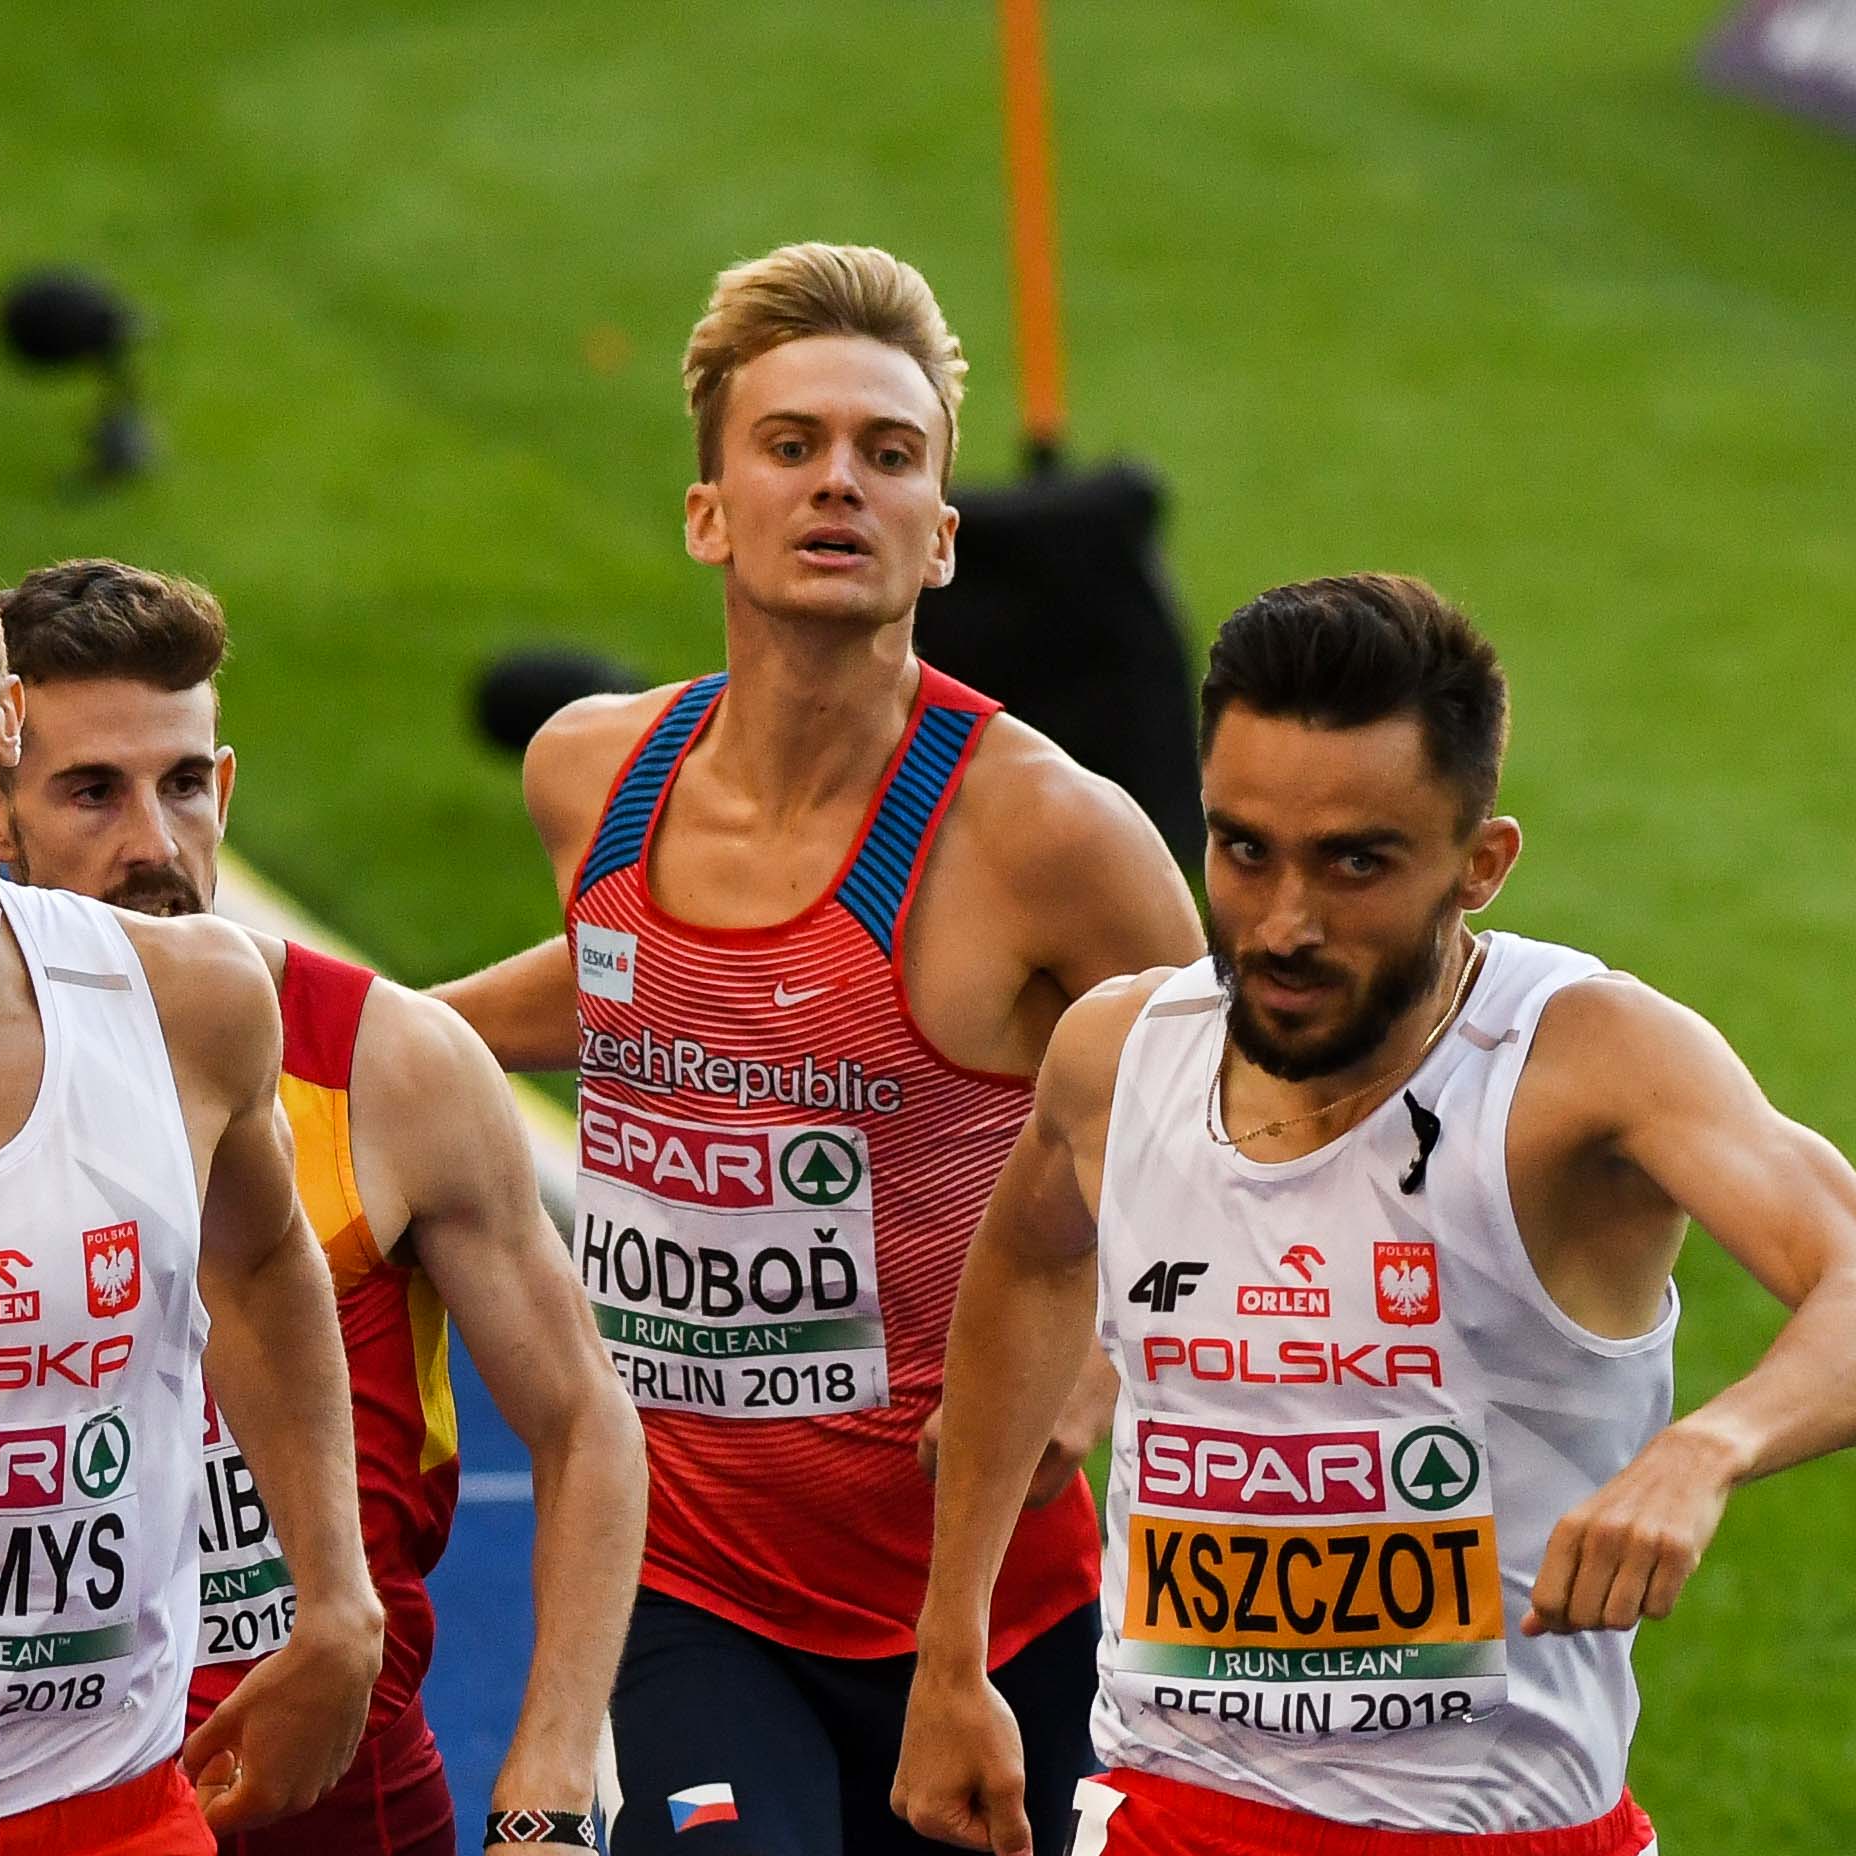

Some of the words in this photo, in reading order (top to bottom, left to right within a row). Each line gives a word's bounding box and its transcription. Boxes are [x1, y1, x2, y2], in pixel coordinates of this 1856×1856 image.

[577, 1014, 902, 1113] zechRepublic
[583, 1112, 765, 1196] SPAR
[87, 1226, 134, 1245] POLSKA
[1377, 1245, 1432, 1257] POLSKA
[582, 1213, 859, 1318] HODBOĎ
[1128, 1261, 1209, 1312] 4F
[1242, 1291, 1326, 1313] ORLEN
[620, 1313, 628, 1339] I
[636, 1318, 686, 1348] RUN
[611, 1351, 726, 1406] ERLIN
[742, 1363, 856, 1407] 2018
[1144, 1337, 1442, 1387] POLSKA
[1144, 1435, 1376, 1502] SPAR
[1144, 1528, 1480, 1635] KSZCZOT
[203, 1595, 297, 1654] 2018
[1208, 1650, 1217, 1676] I
[1225, 1651, 1290, 1677] RUN
[0, 1674, 105, 1717] 2018
[1350, 1691, 1473, 1734] 2018
